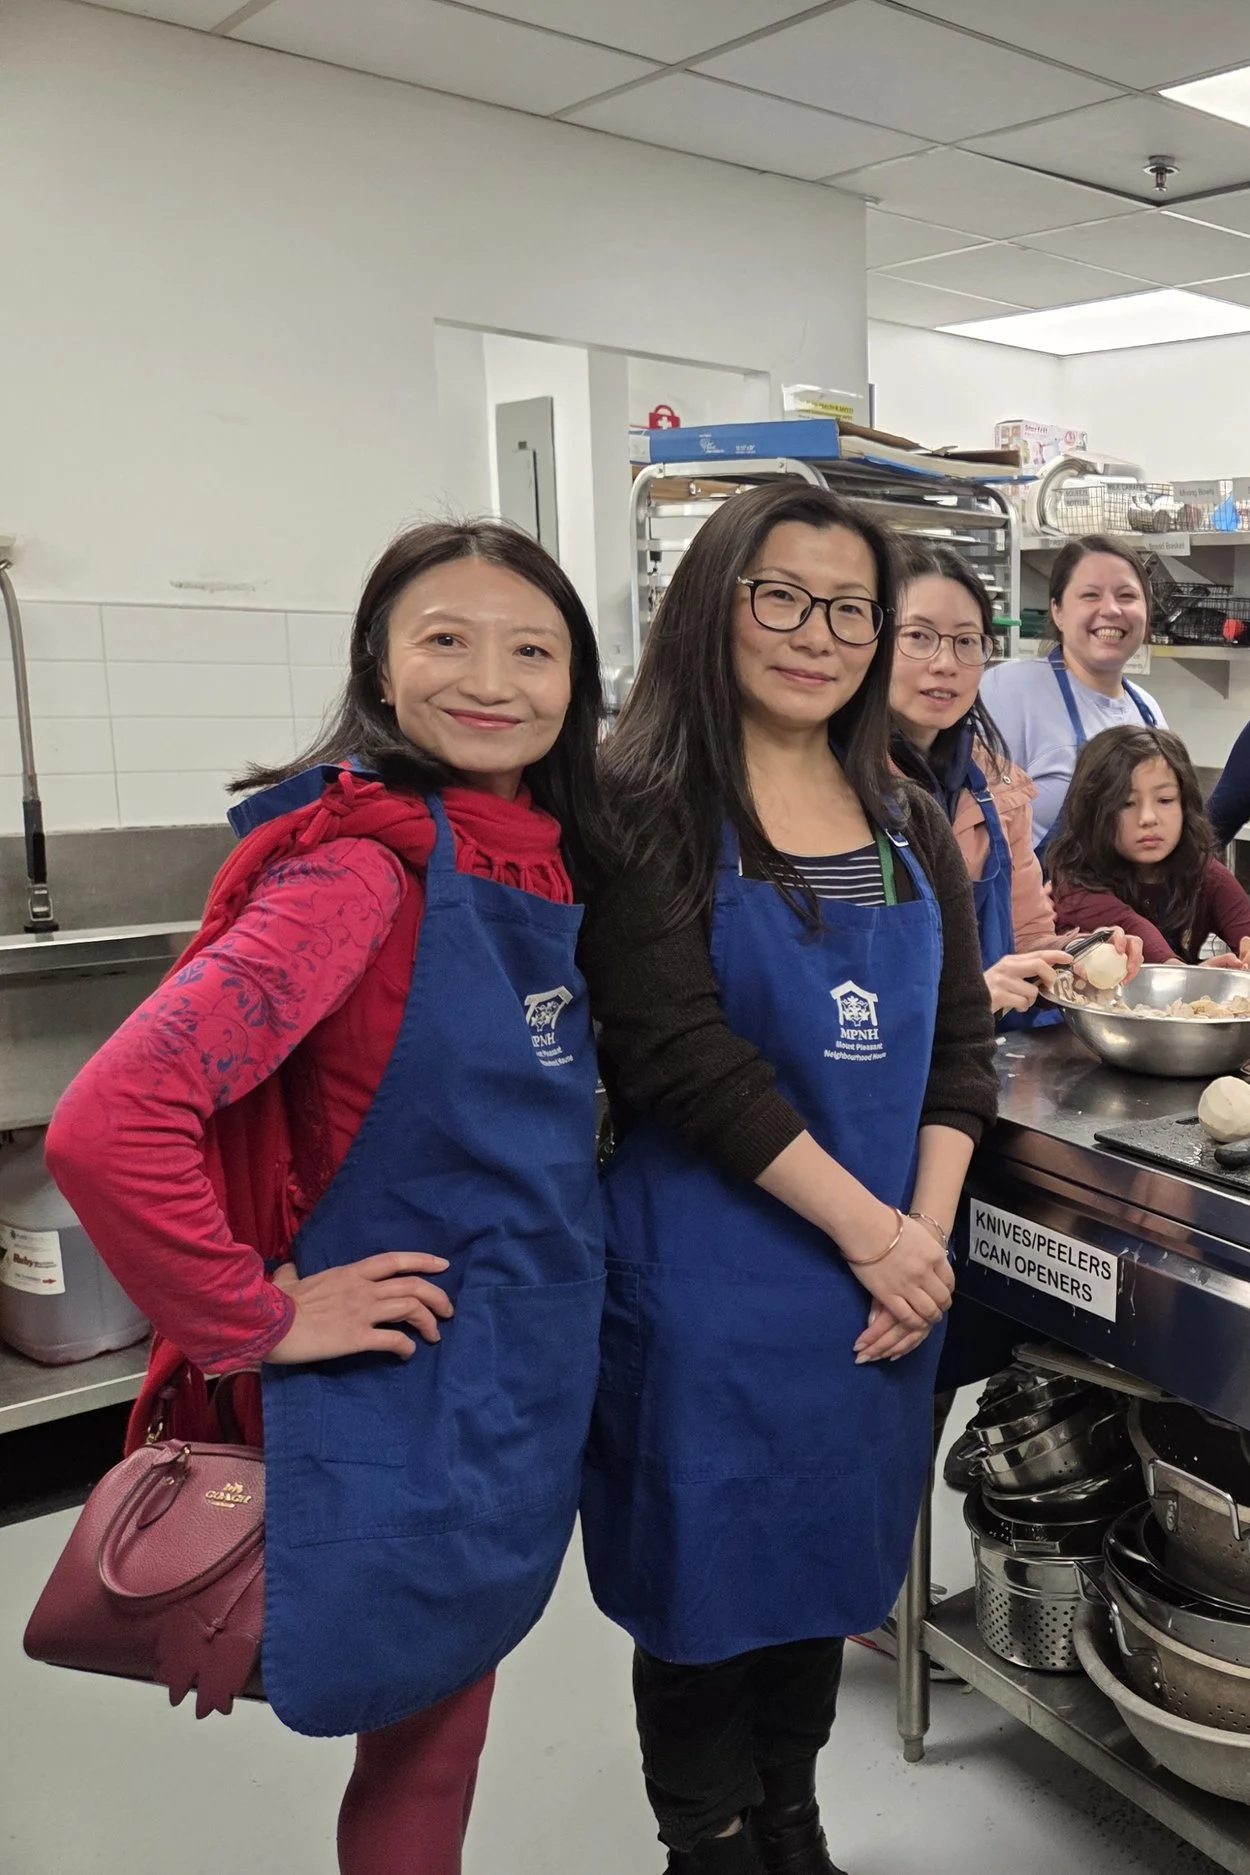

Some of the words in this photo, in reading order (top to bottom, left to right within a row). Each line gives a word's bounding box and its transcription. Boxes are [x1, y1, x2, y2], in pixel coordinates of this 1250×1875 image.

[840, 1028, 879, 1041] MPNH
[835, 1040, 855, 1051] Mount
[856, 1043, 883, 1051] Pleasant
[823, 1049, 872, 1061] Neighbourhood
[976, 1209, 1112, 1280] KNIVES/PEELERS
[974, 1238, 1011, 1269] /CAN
[1014, 1255, 1093, 1302] OPENERS
[205, 1490, 252, 1504] COACH
